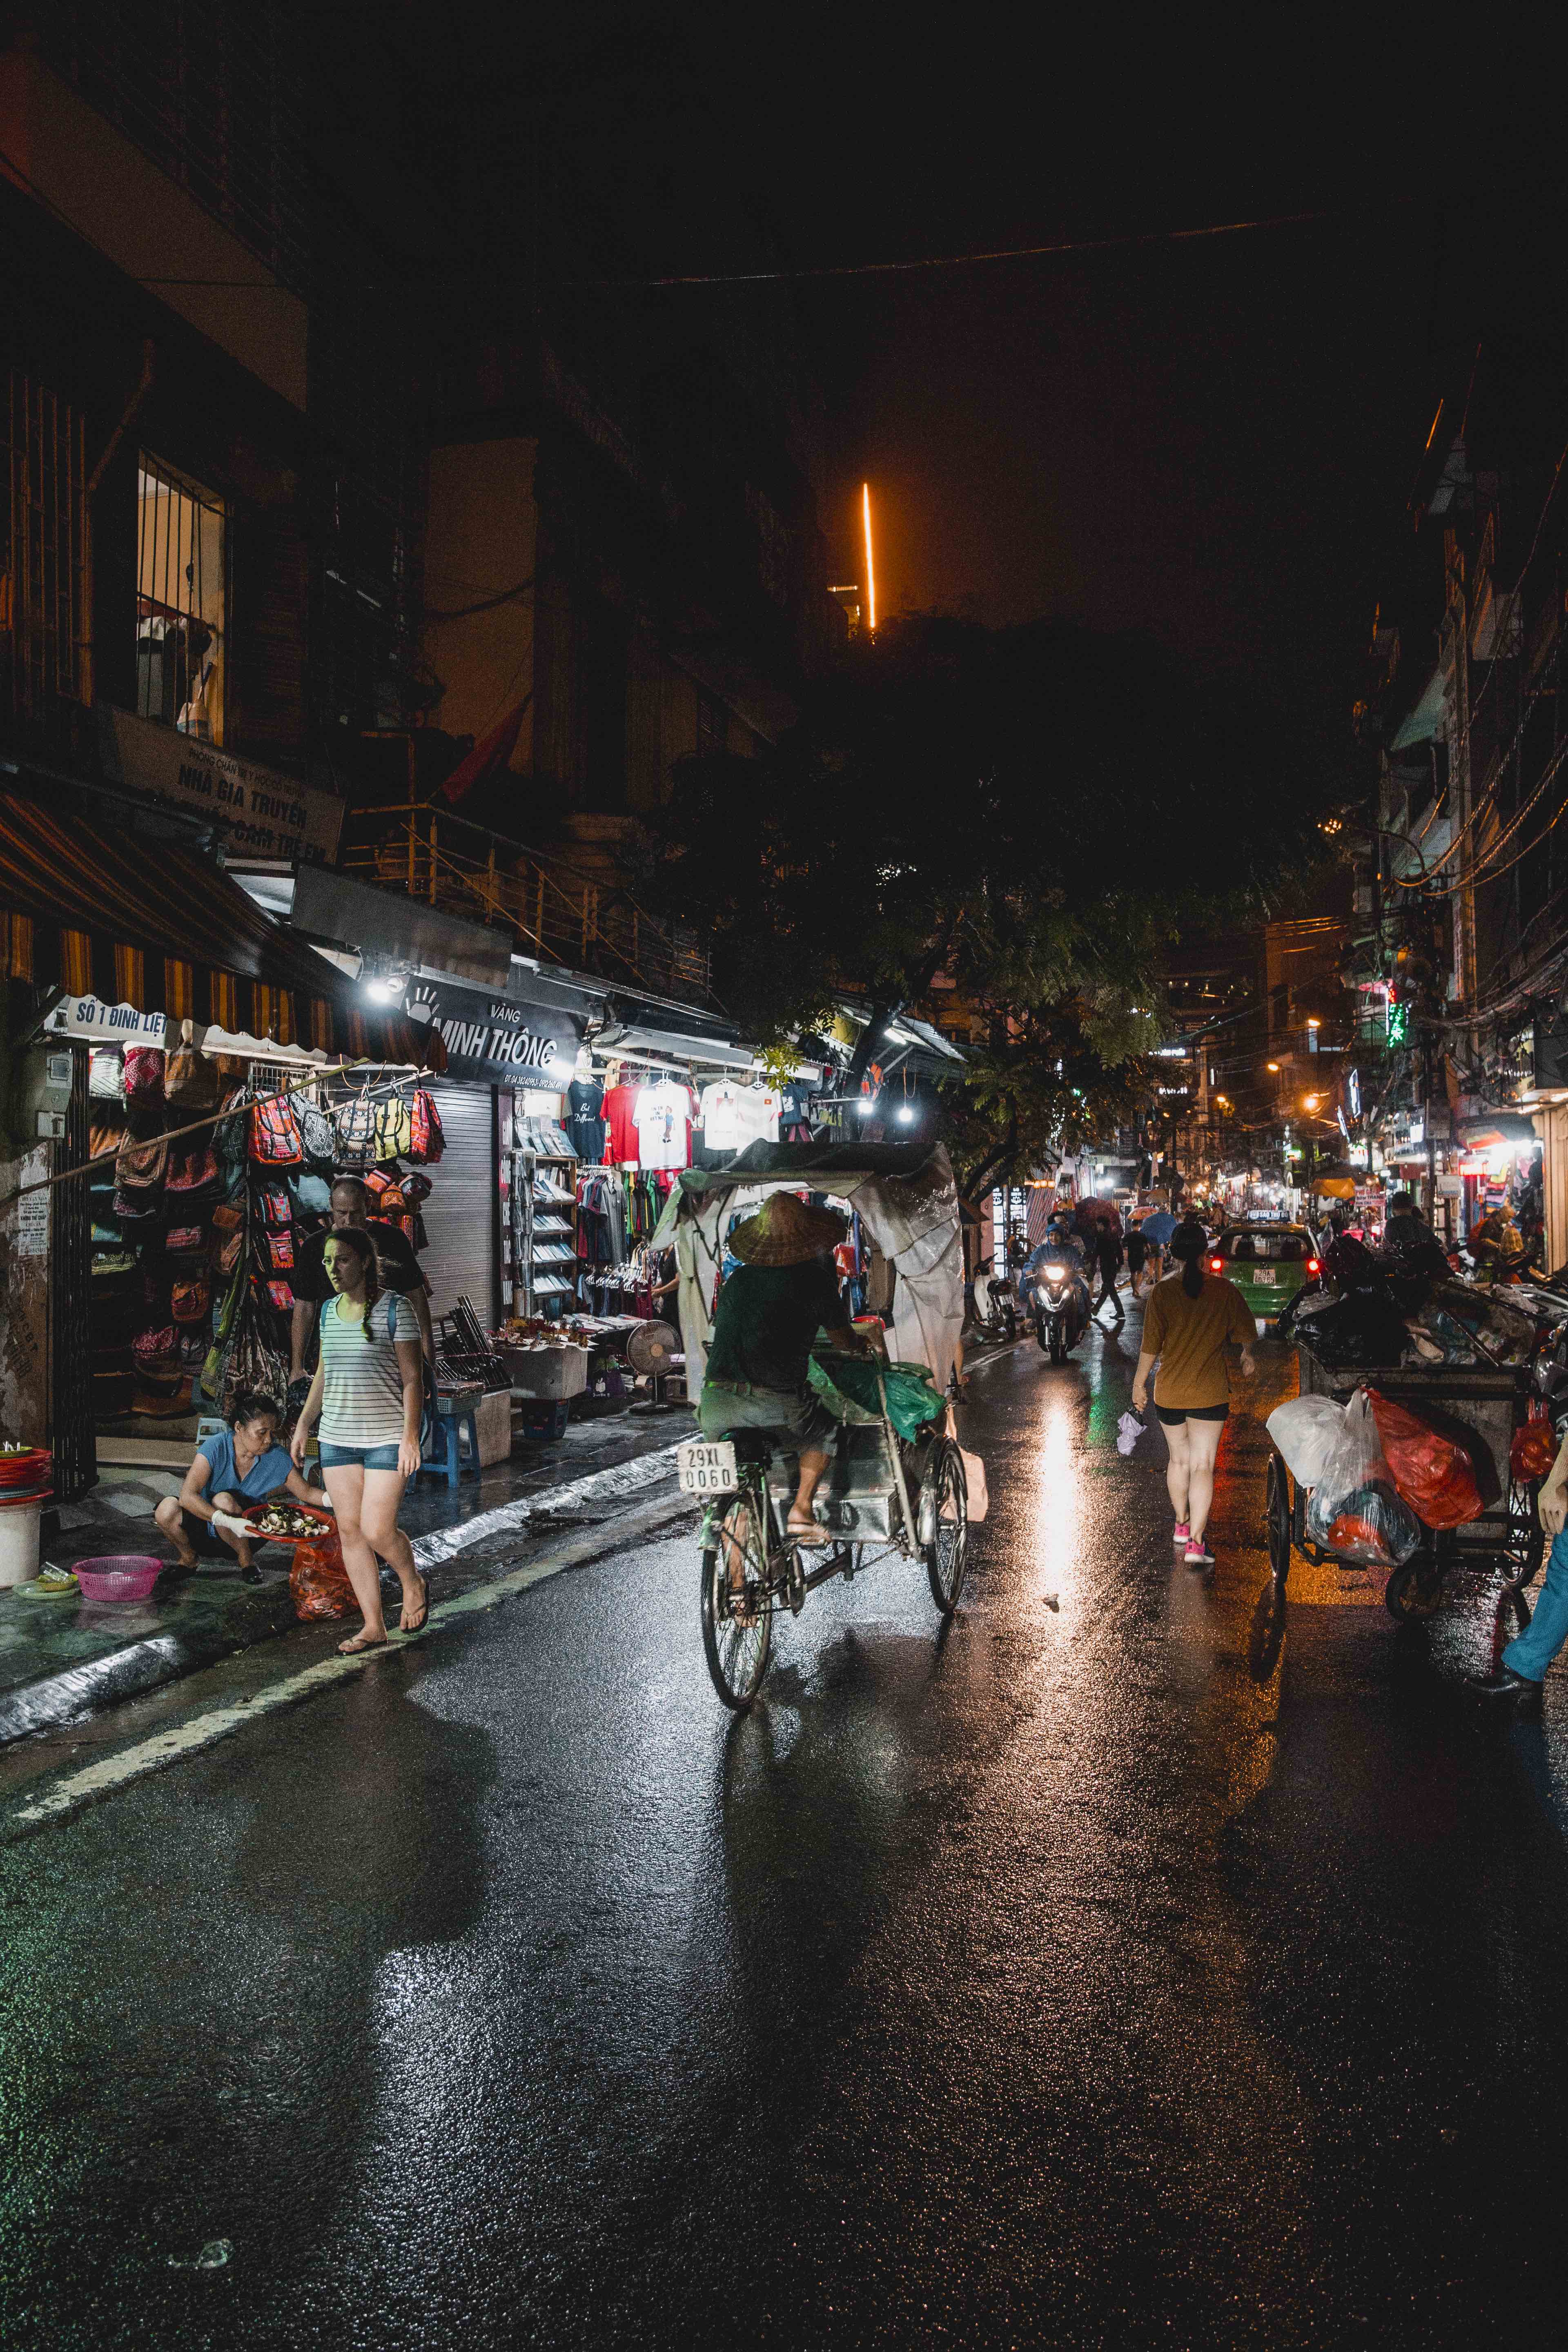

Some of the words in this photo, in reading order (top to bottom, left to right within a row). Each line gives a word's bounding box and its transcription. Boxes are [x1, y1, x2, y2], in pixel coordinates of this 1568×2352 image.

[218, 778, 244, 807] GIA
[76, 998, 98, 1023] SỐ
[99, 1007, 105, 1025] 1
[109, 1008, 140, 1030] ĐINH
[143, 1012, 168, 1037] LIỆT
[491, 1003, 521, 1023] VÀNG
[488, 1026, 557, 1069] THÔNG
[575, 1113, 595, 1123] Different
[688, 1448, 723, 1467] 29XL
[686, 1468, 731, 1488] 0060
